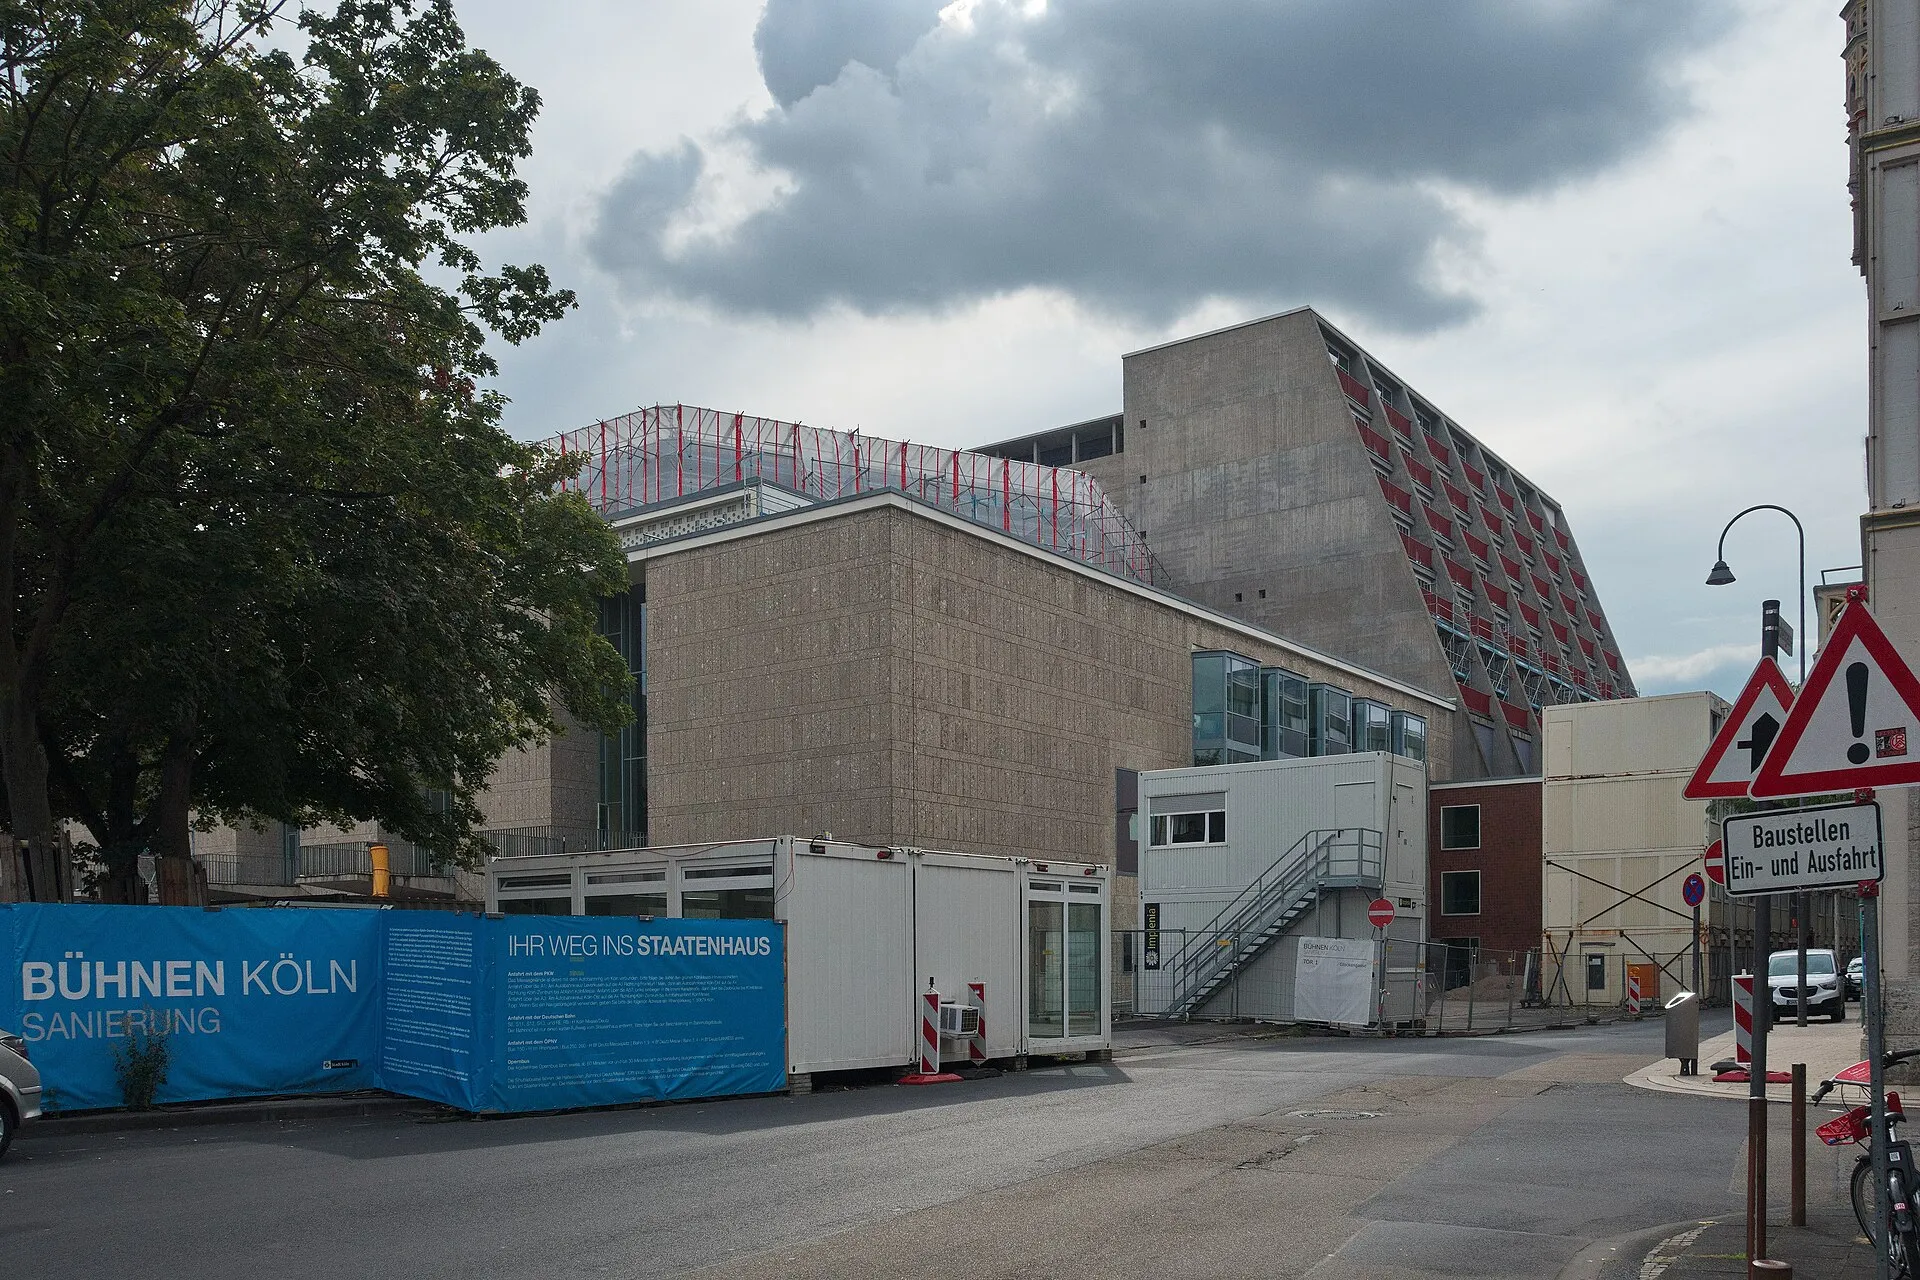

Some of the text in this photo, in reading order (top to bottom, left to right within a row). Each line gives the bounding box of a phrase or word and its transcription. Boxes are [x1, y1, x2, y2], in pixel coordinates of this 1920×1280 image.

[1753, 819, 1850, 849] Baustellen
[1731, 846, 1877, 880] Ein- und Ausfahrt
[509, 935, 771, 956] IHR WEG INS STAATENHAUS
[1147, 908, 1158, 949] Implenia
[1303, 943, 1328, 951] BÜHNEN
[22, 951, 357, 1000] BÜHNEN KÖLN
[22, 1007, 221, 1042] SANIERUNG
